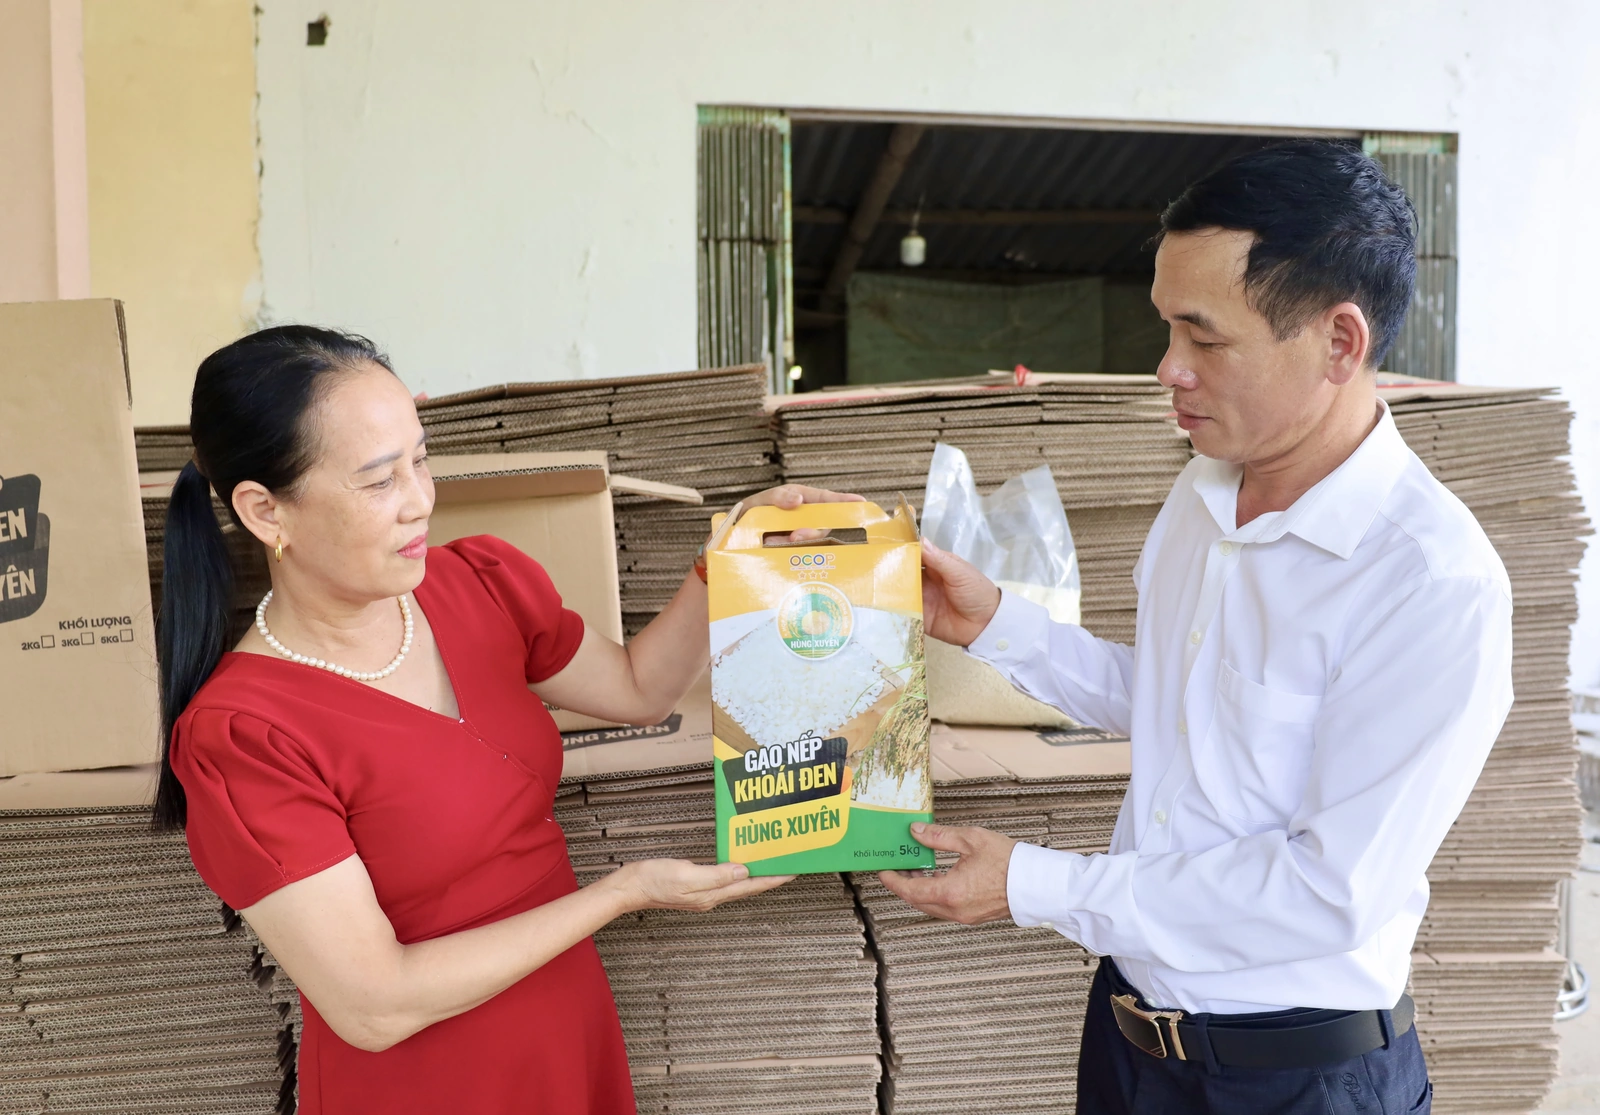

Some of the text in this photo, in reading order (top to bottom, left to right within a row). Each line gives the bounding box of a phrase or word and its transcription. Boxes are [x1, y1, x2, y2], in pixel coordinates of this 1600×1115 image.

[790, 553, 835, 566] OCOP
[59, 616, 132, 630] KHỐI LƯỢNG
[21, 635, 119, 650] 2KG 3KG 5KG
[790, 637, 840, 649] HÙNG XUYÊN
[604, 724, 670, 740] XUYÊN
[744, 730, 823, 775] GẠO NẾP
[734, 762, 837, 803] KHOÁI ĐEN
[735, 805, 840, 847] HÙNG XUYÊN
[853, 845, 920, 858] Khối lượng: 5kg
